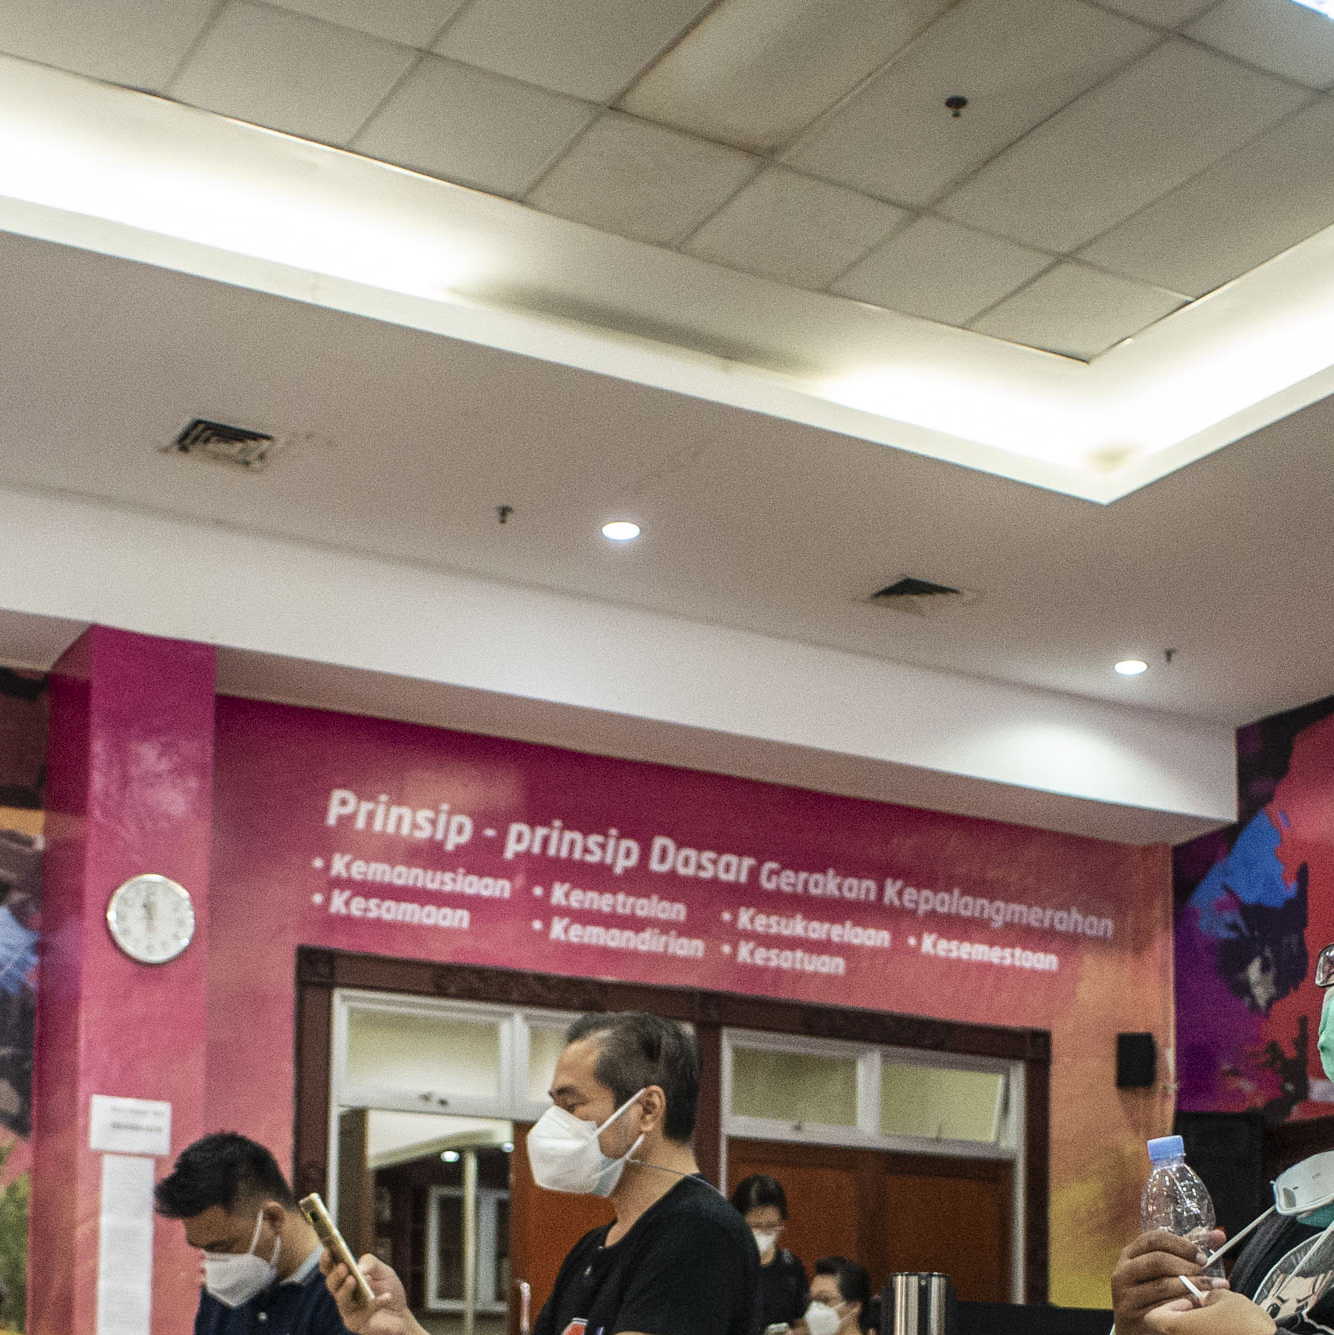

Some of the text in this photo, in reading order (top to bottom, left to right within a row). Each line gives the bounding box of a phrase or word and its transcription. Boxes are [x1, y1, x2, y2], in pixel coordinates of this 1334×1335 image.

[325, 788, 474, 852] Prinsip
[503, 819, 641, 876] prinsip
[649, 834, 756, 884] Dasar
[759, 861, 878, 903] Gerakan
[883, 877, 1115, 941] Kepalangmerahan
[329, 852, 512, 900] Kemanusiaan
[328, 887, 471, 930] Kesamaan
[550, 881, 688, 923] Kenetralan
[549, 915, 706, 959] Kemandirian
[736, 906, 892, 949] Kesukarelaan
[735, 939, 846, 976] Kesatuan
[919, 932, 1061, 973] Kesemestaan
